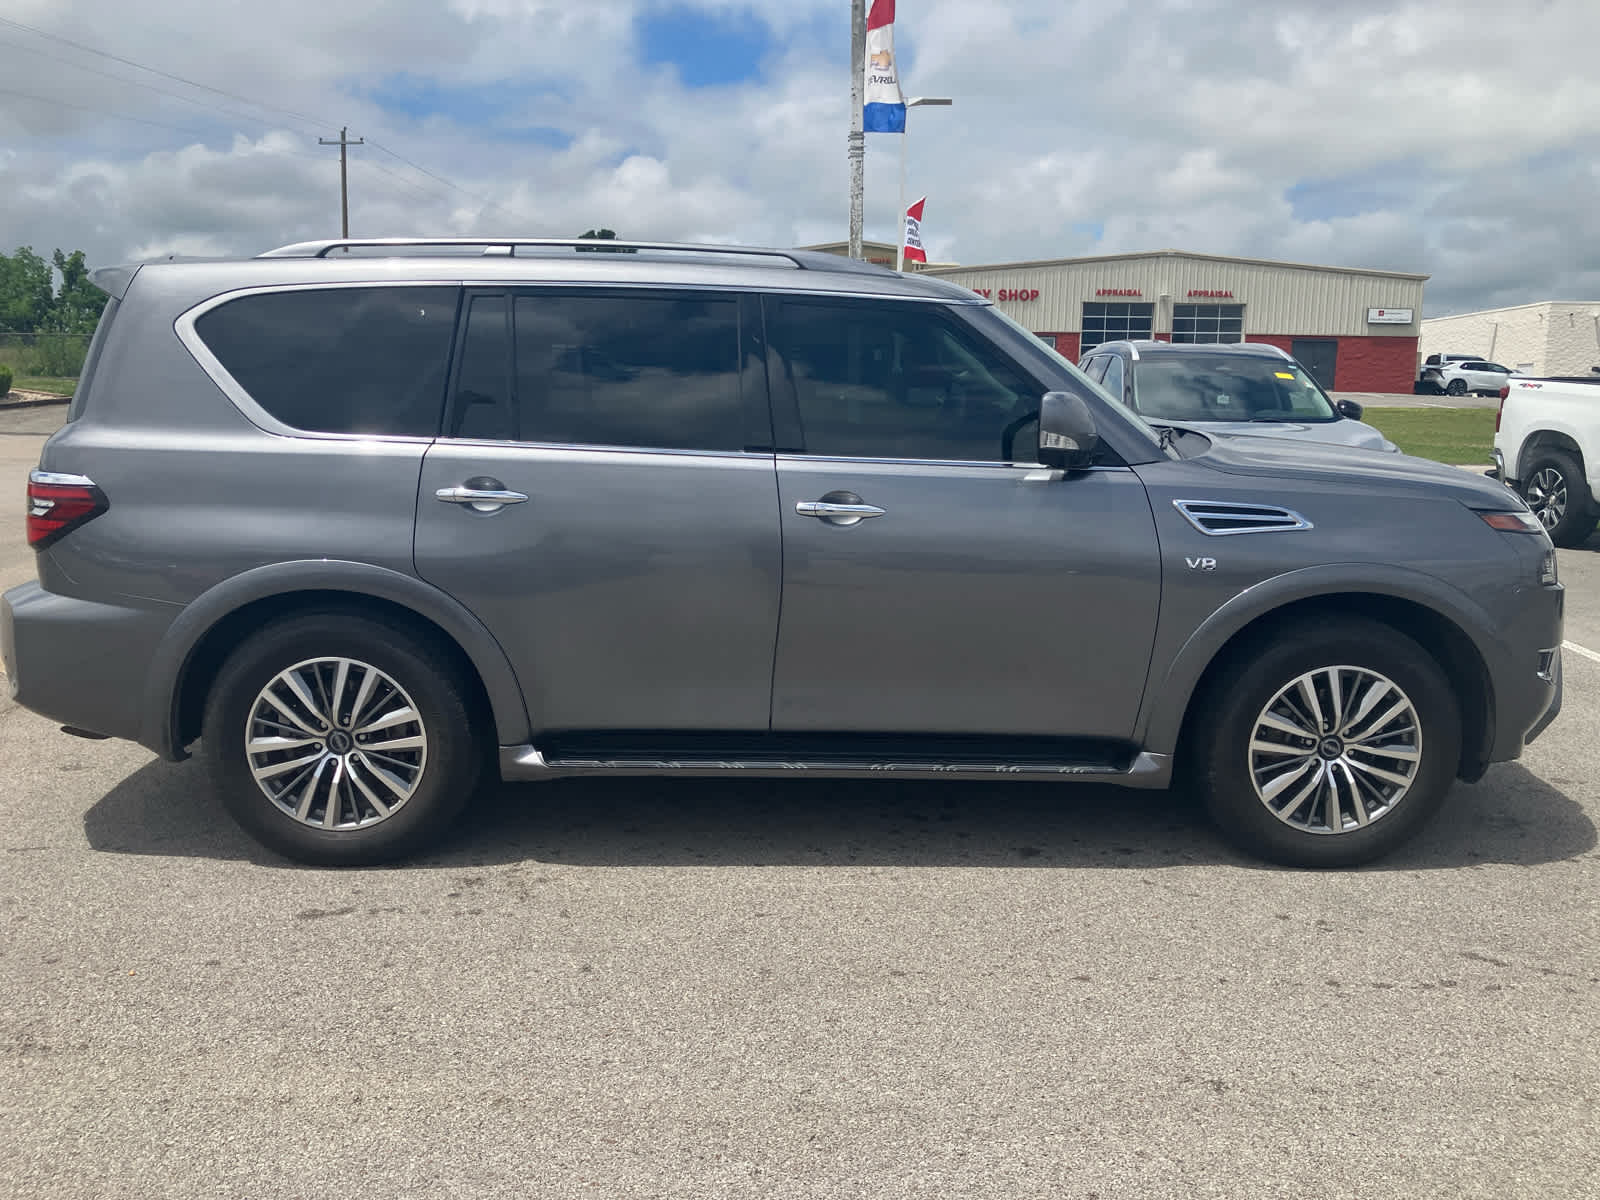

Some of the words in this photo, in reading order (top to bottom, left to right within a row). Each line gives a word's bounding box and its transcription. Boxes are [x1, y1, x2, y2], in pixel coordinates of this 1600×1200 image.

[998, 288, 1039, 302] SHOP
[1096, 288, 1142, 297] APPRAISAL
[1187, 289, 1234, 298] APPRAISAL
[1184, 557, 1217, 570] V8
